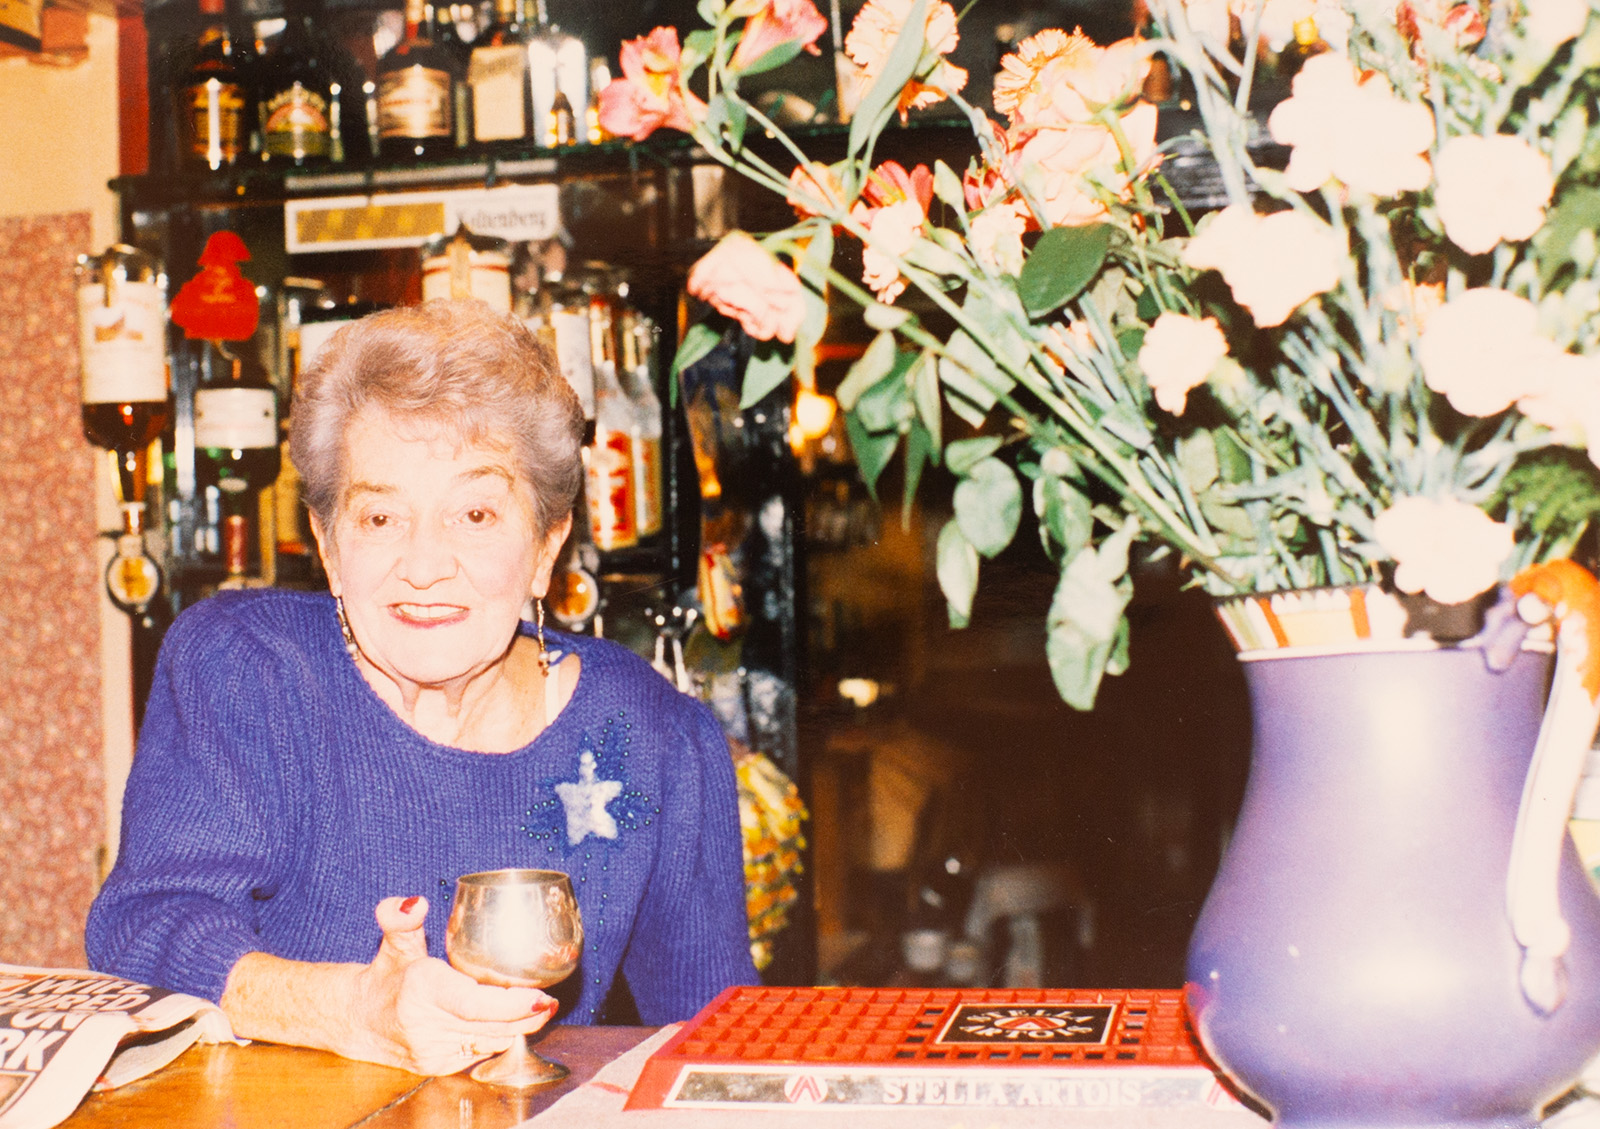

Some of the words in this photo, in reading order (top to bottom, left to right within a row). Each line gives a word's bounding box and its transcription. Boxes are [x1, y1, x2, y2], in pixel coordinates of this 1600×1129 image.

[28, 979, 153, 995] WIFE
[966, 1009, 1095, 1023] STELLA
[958, 1025, 1094, 1039] ARTOIS
[882, 1077, 1009, 1105] STELLA
[1015, 1078, 1142, 1107] ARTOIS
